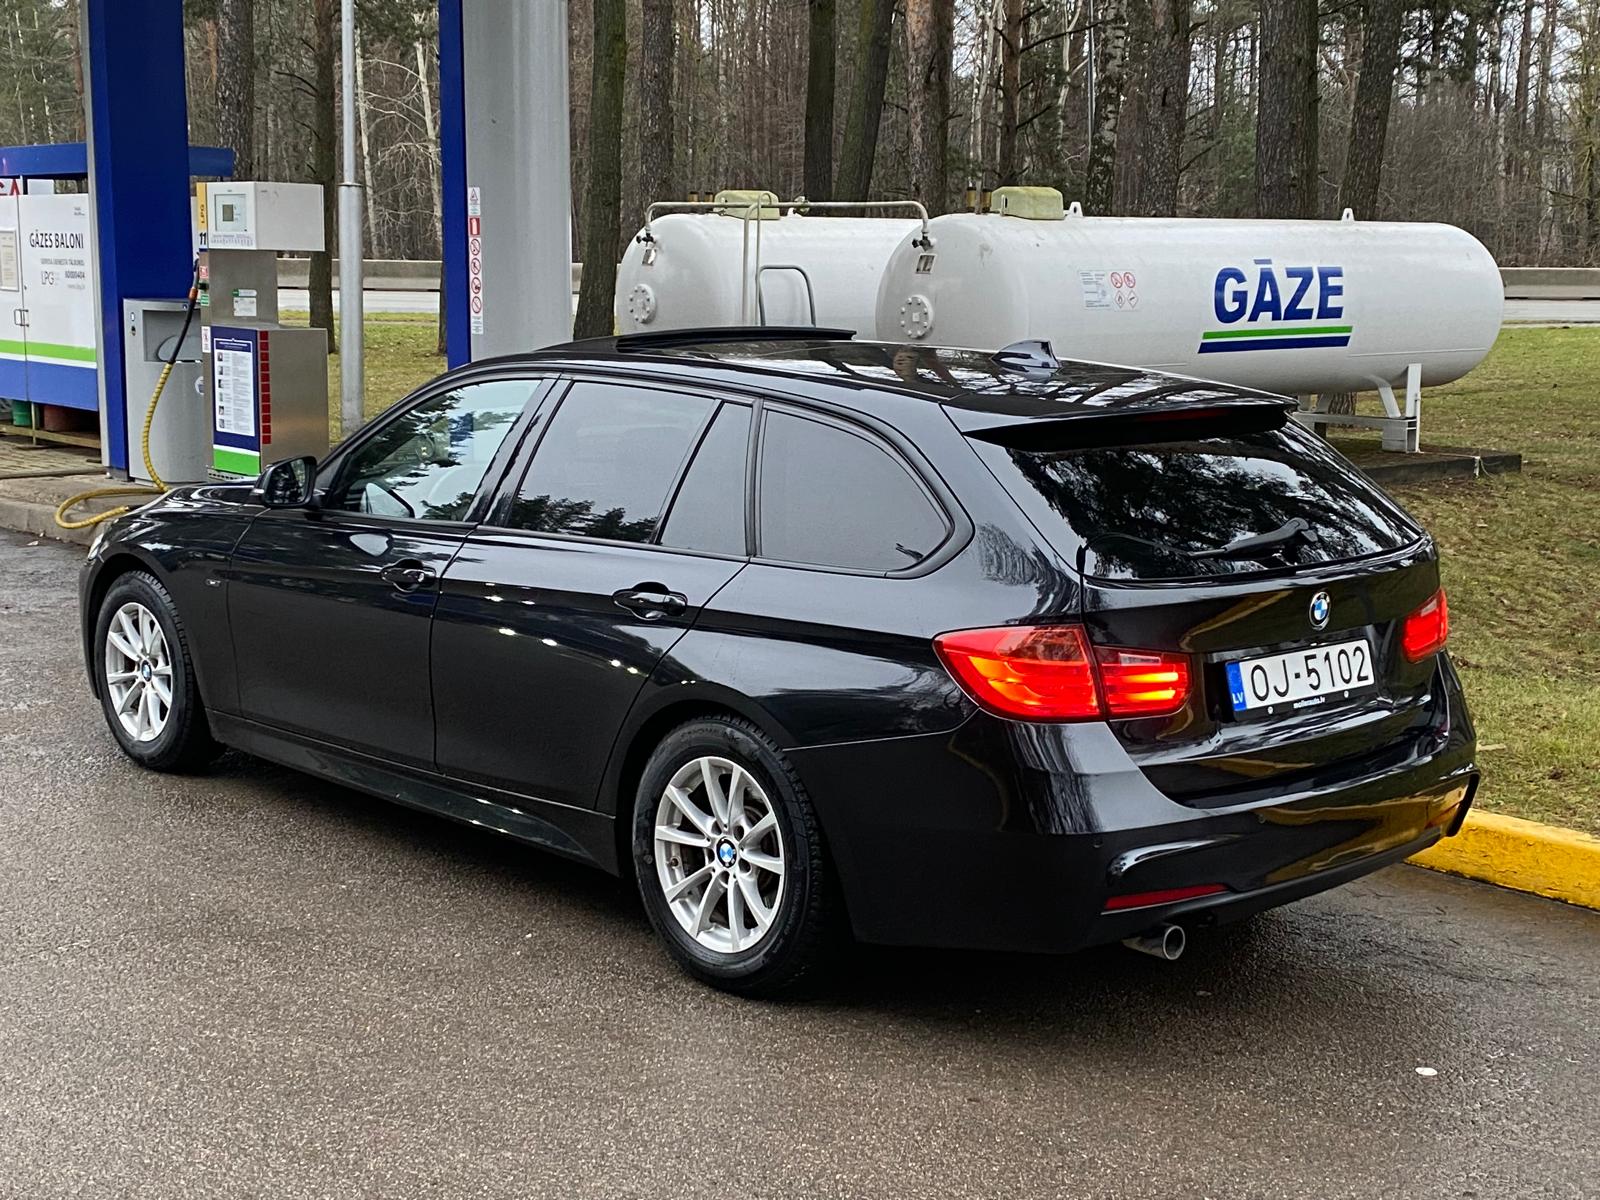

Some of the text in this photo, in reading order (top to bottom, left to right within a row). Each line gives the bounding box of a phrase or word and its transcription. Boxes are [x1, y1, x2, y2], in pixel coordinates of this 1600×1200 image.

[29, 229, 84, 249] GĀZES BALONI
[200, 232, 207, 245] 11
[1213, 258, 1344, 324] GĀZE
[1251, 646, 1369, 702] OJ-5102
[1232, 692, 1244, 704] LV
